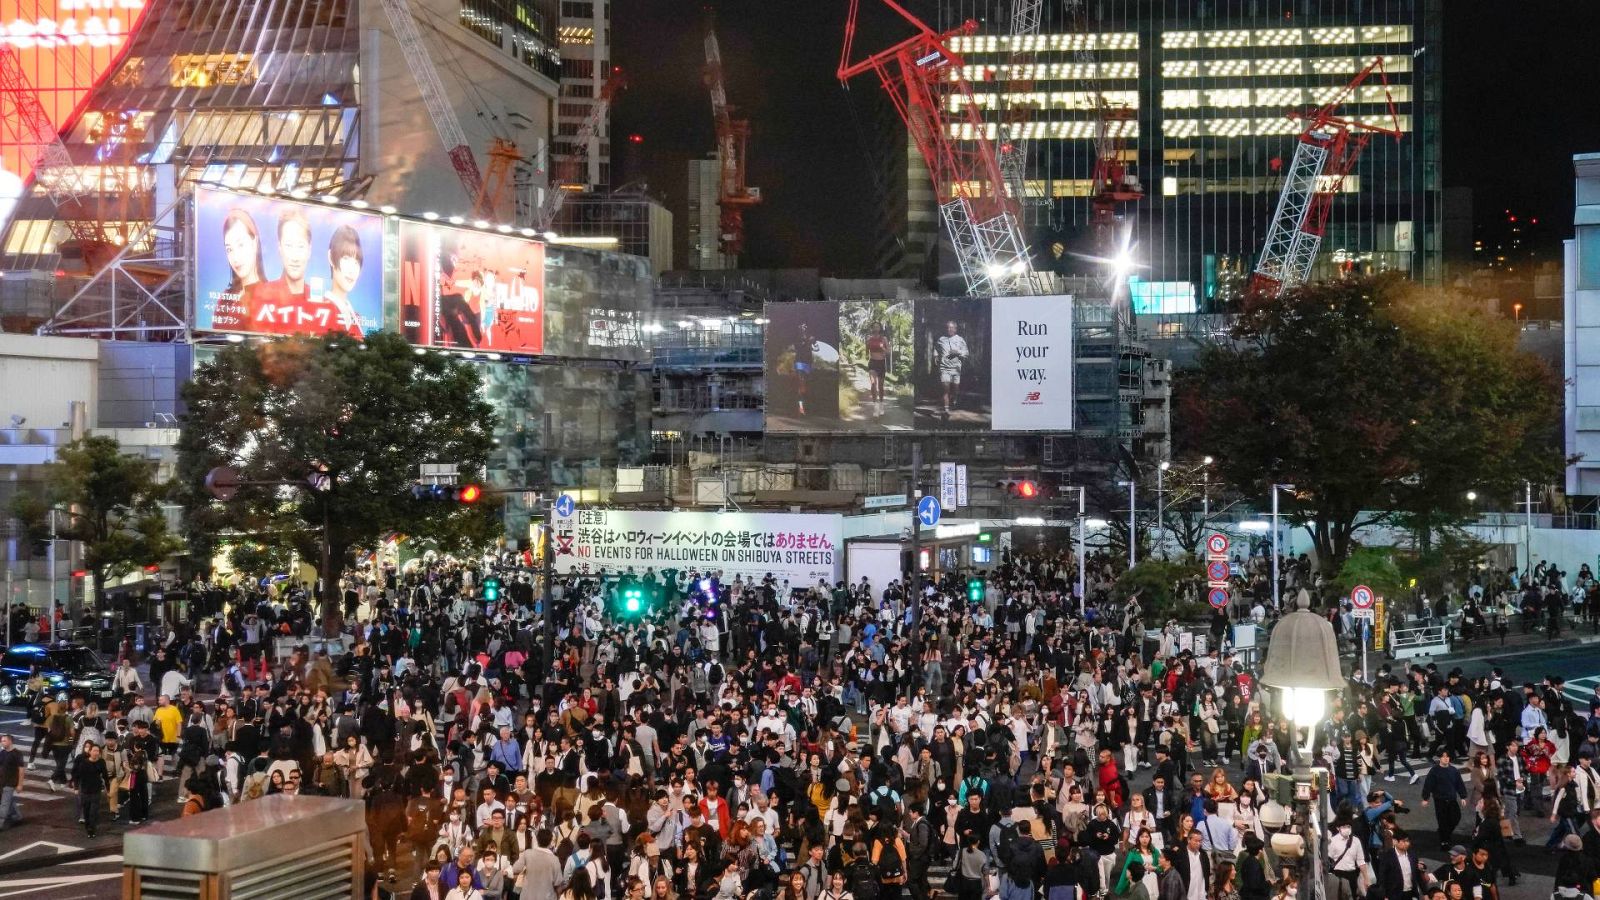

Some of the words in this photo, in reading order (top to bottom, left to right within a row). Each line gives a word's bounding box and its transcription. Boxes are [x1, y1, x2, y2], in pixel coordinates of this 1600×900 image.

[404, 261, 421, 306] N
[256, 303, 331, 327] ペイトク
[1018, 320, 1048, 336] Run
[1015, 345, 1049, 363] your
[1017, 367, 1047, 385] way.
[578, 527, 835, 551] 渋谷はハロウィーンイベントの会場ではありません。
[578, 546, 591, 558] NO
[594, 546, 632, 560] EVENTS
[635, 547, 653, 560] FOR
[656, 547, 718, 562] HALLOWEEN
[721, 549, 736, 562] ON
[737, 549, 782, 564] SHIBUYA
